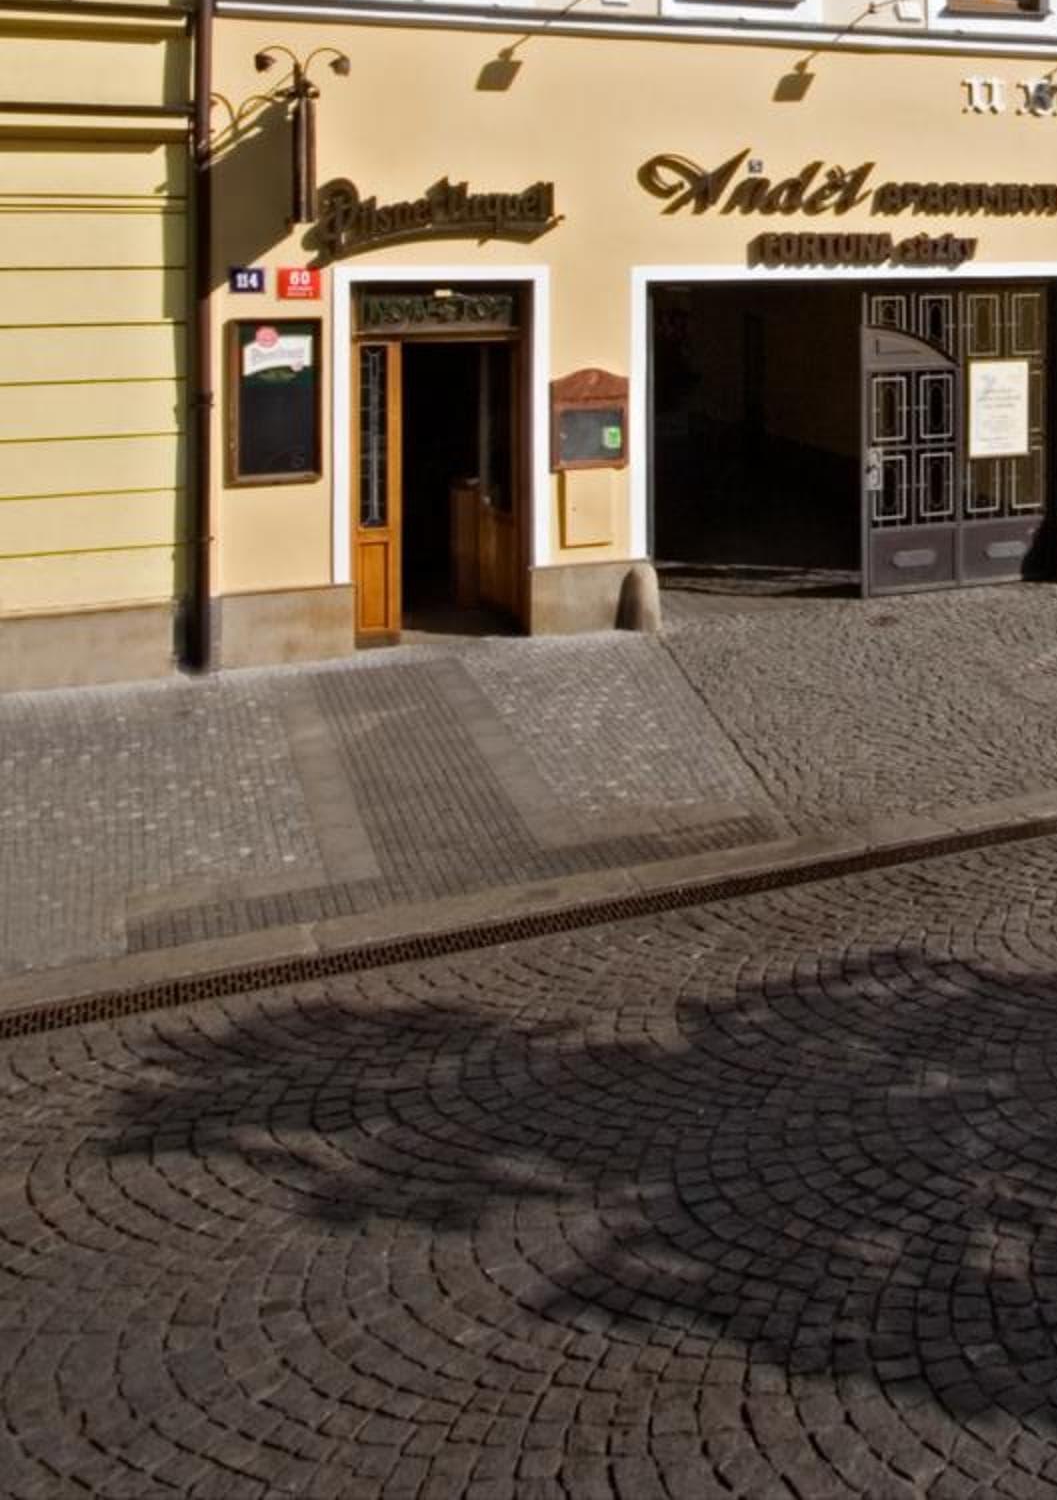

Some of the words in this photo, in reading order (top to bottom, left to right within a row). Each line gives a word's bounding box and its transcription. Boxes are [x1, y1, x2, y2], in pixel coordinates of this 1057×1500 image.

[637, 148, 876, 216] Anděl
[748, 232, 896, 270] FORTUNA
[236, 273, 259, 289] 114
